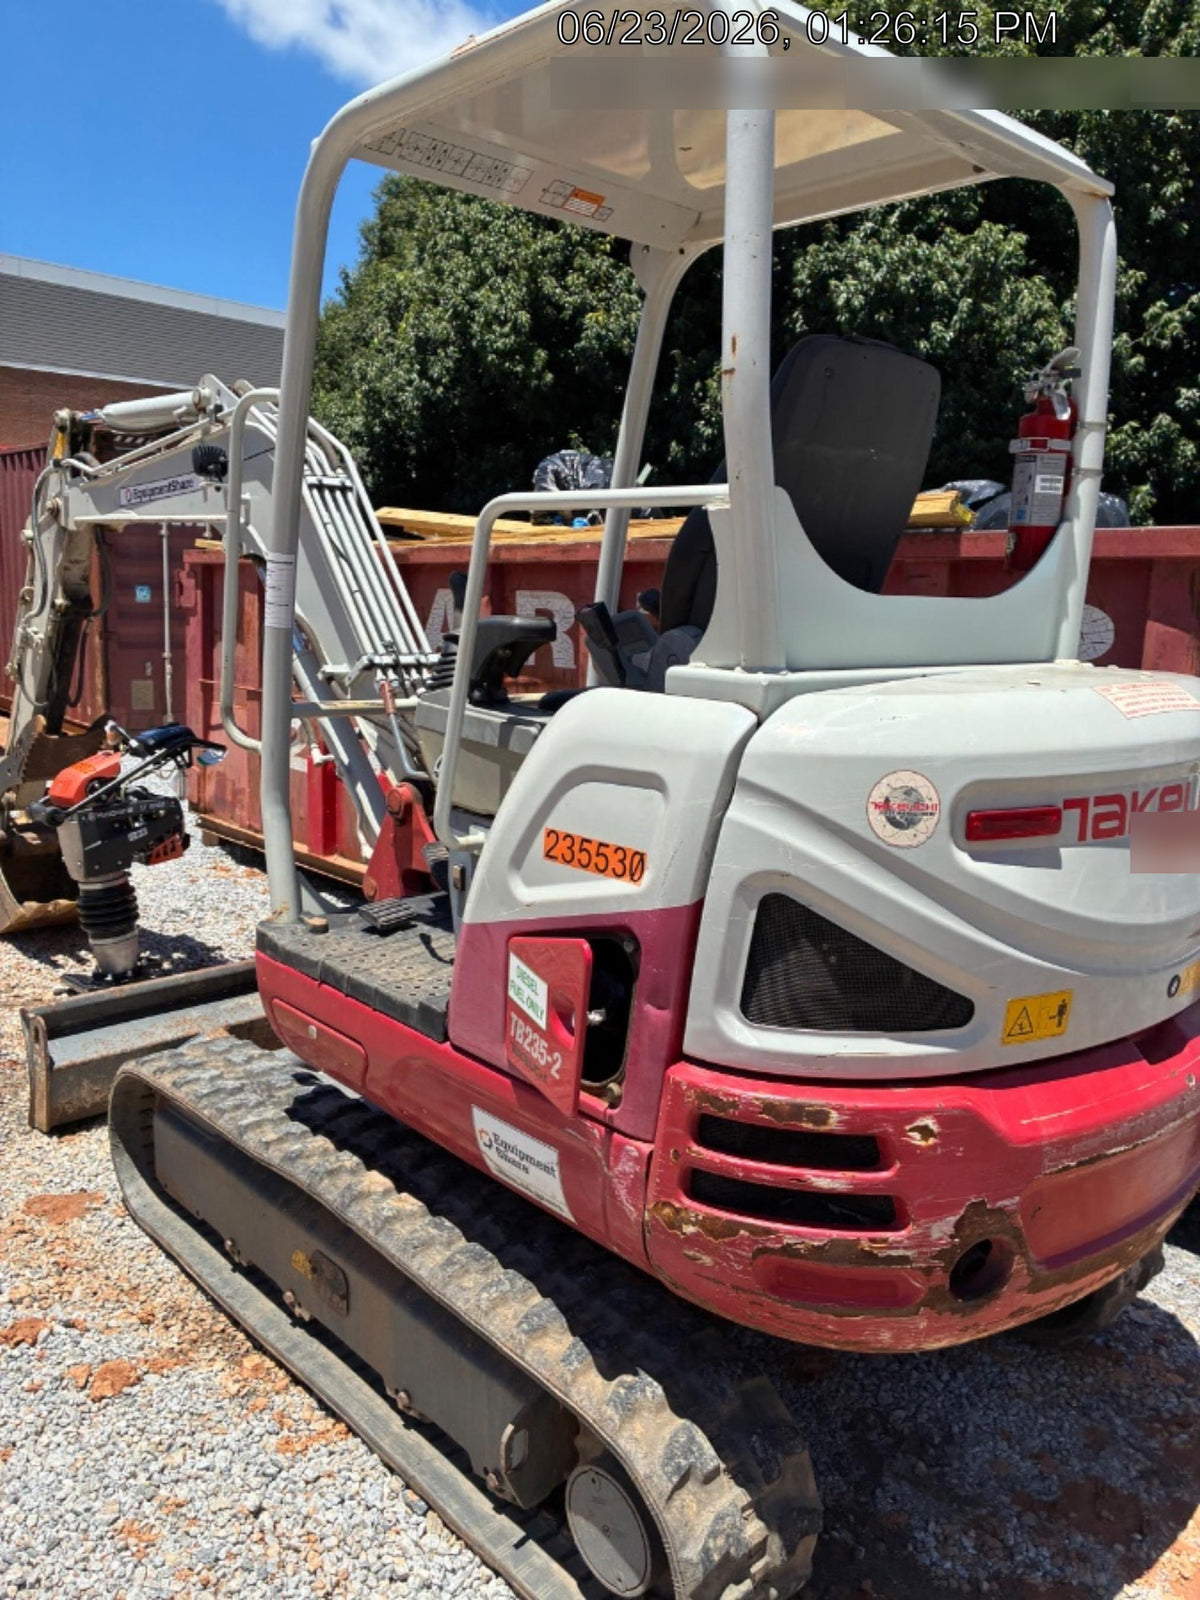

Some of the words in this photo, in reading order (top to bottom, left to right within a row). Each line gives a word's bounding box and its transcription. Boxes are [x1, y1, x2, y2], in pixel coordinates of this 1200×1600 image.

[544, 829, 645, 883] 235530
[510, 979, 525, 1004] FUEL
[526, 995, 545, 1021] ONLY
[510, 1011, 562, 1080] TB235-2
[493, 1131, 557, 1180] Equipment
